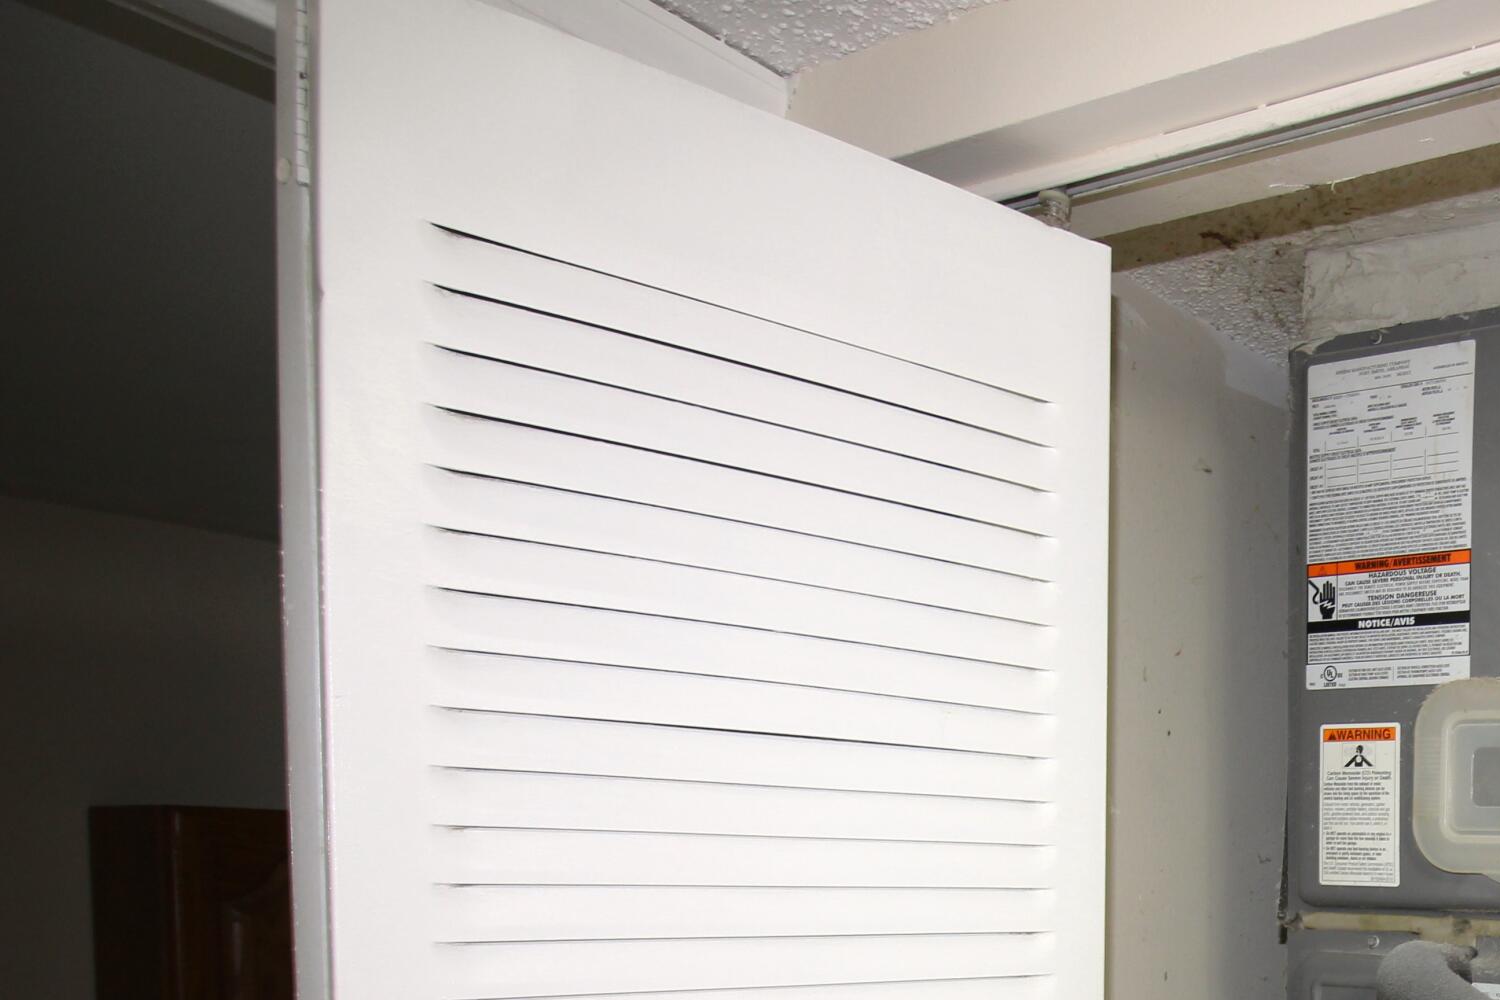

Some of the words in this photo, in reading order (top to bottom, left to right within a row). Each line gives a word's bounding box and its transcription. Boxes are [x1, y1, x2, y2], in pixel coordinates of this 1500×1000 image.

[1408, 567, 1437, 576] VOLTAGE
[1367, 593, 1395, 602] TENSION
[1396, 590, 1437, 599] DANGEREUSE
[1358, 616, 1416, 629] NOTICE/AVIS
[1336, 728, 1391, 740] WARNING
